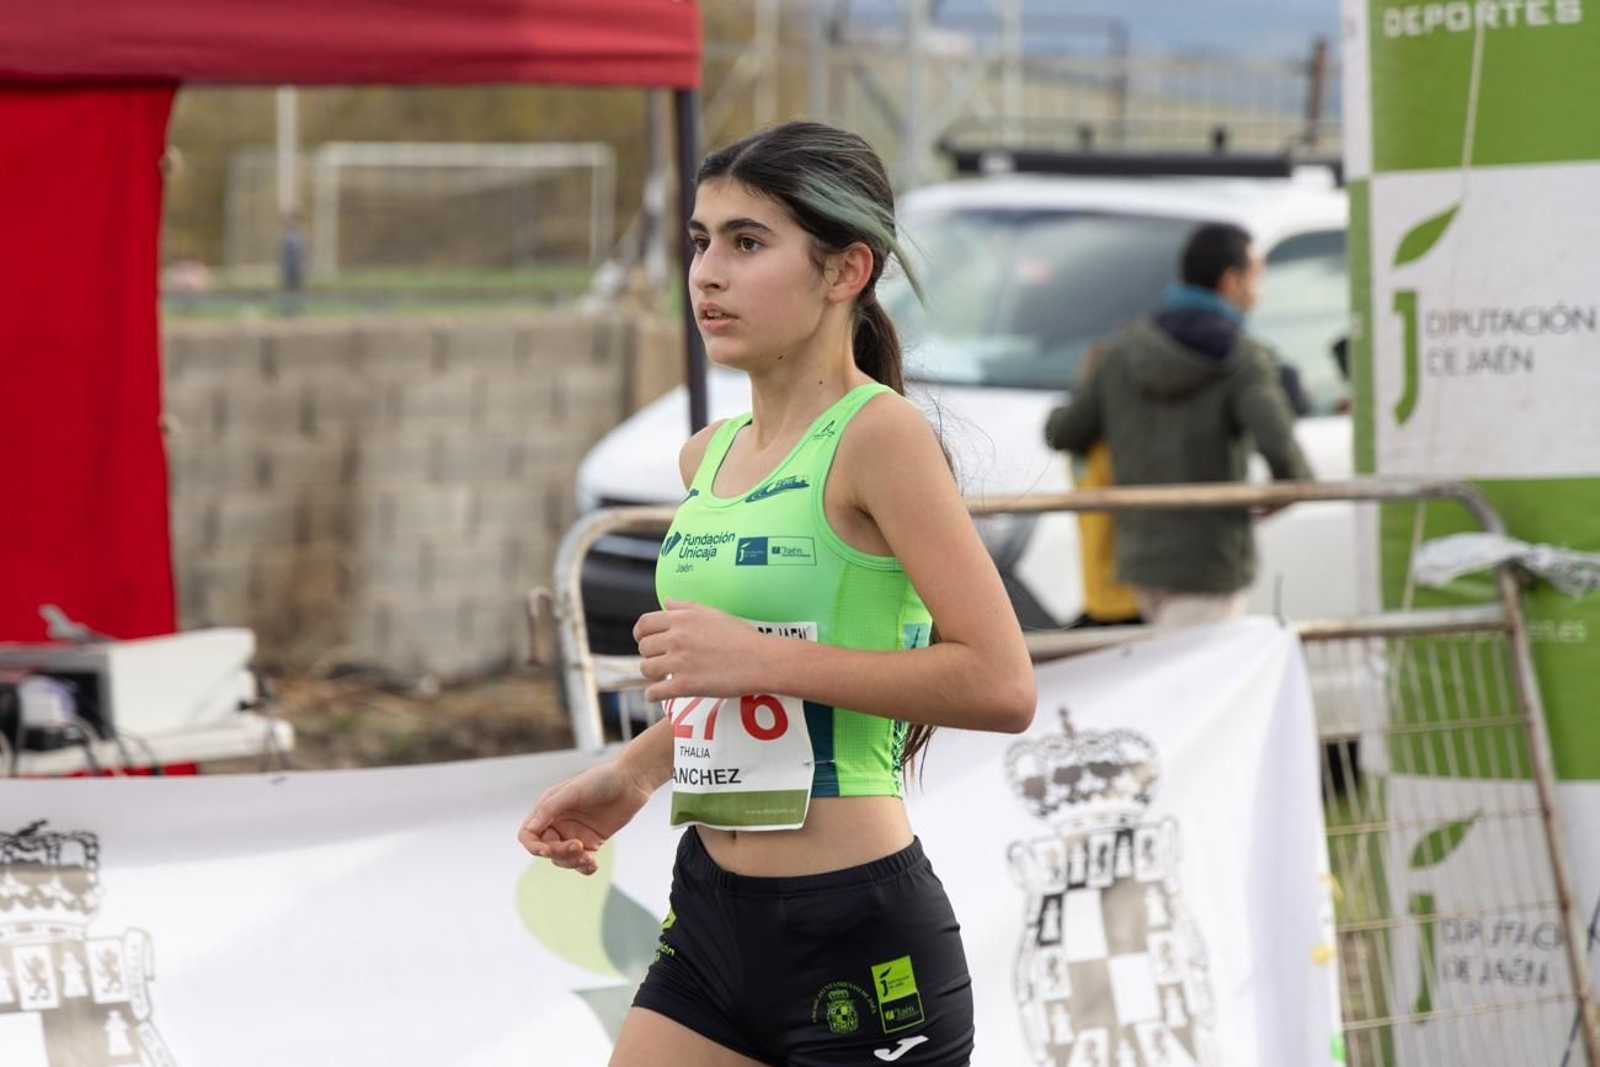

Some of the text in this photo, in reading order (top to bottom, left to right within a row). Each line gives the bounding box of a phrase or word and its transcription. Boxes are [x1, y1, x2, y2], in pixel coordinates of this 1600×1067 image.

[1384, 0, 1583, 38] DEPORTES
[683, 531, 735, 546] Fundación
[679, 545, 717, 561] Unicaja
[666, 694, 788, 741] 276
[679, 746, 711, 759] THALIA
[672, 767, 742, 786] ANCHEZ
